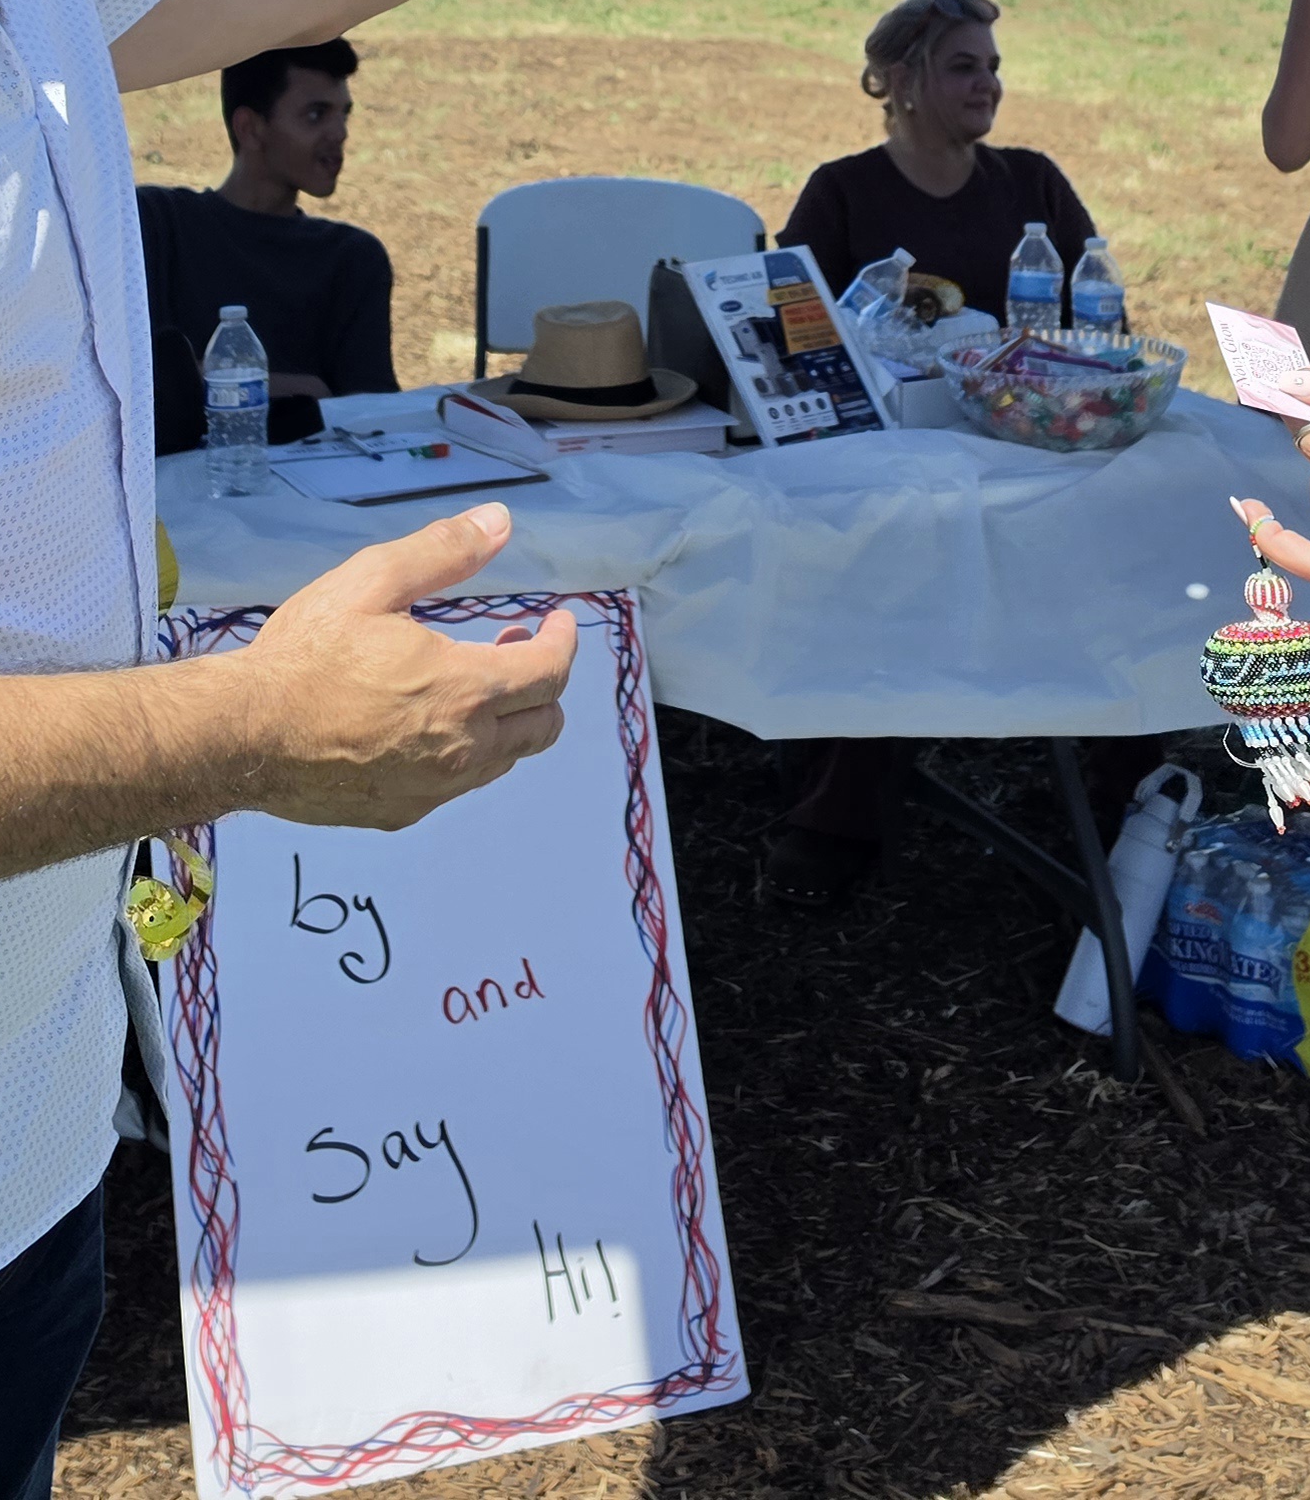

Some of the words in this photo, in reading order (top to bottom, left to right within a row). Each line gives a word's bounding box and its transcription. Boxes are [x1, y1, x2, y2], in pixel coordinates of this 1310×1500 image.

[290, 852, 391, 984] by
[441, 958, 546, 1025] and
[533, 1219, 622, 1324] Hi!
